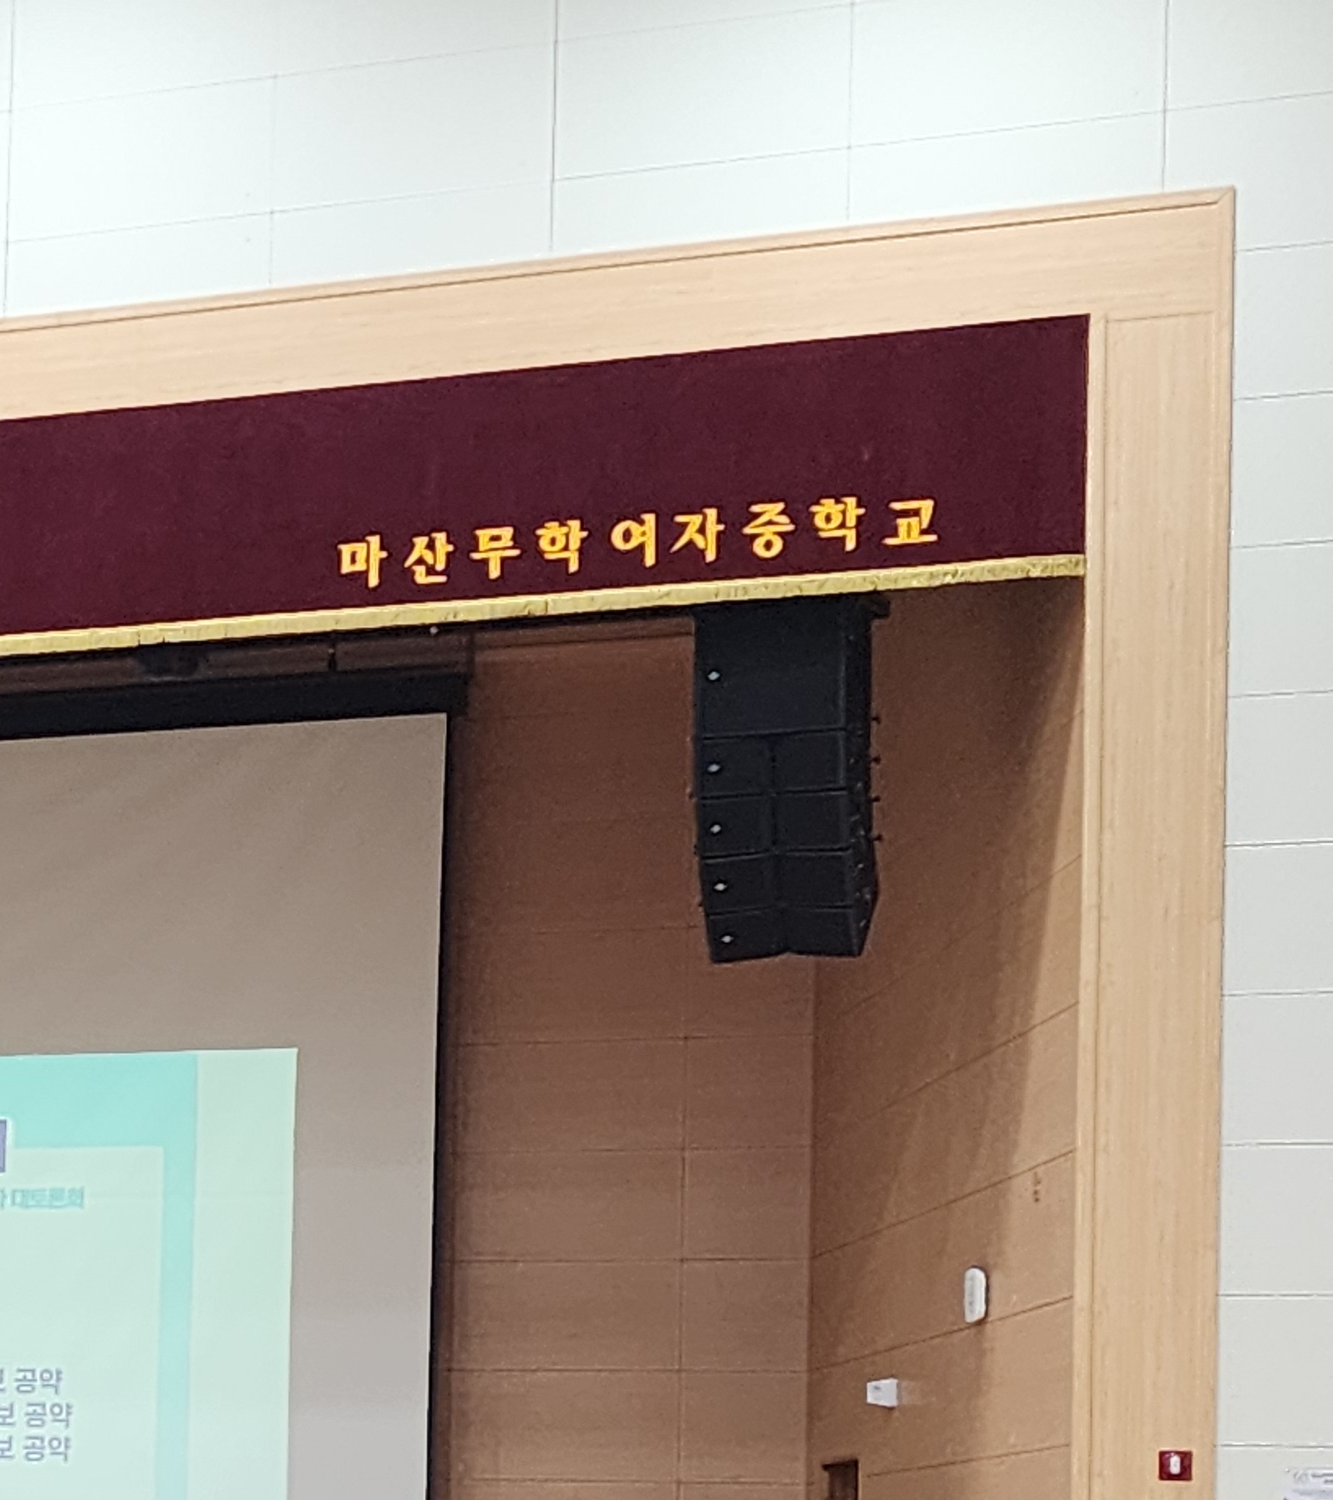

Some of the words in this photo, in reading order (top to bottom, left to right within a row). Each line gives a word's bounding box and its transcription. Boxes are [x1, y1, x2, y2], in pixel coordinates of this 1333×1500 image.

[337, 497, 938, 588] 마산무학여자중학교
[14, 1367, 63, 1395] 공약
[24, 1401, 73, 1429] 공약
[23, 1434, 72, 1462] 공약
